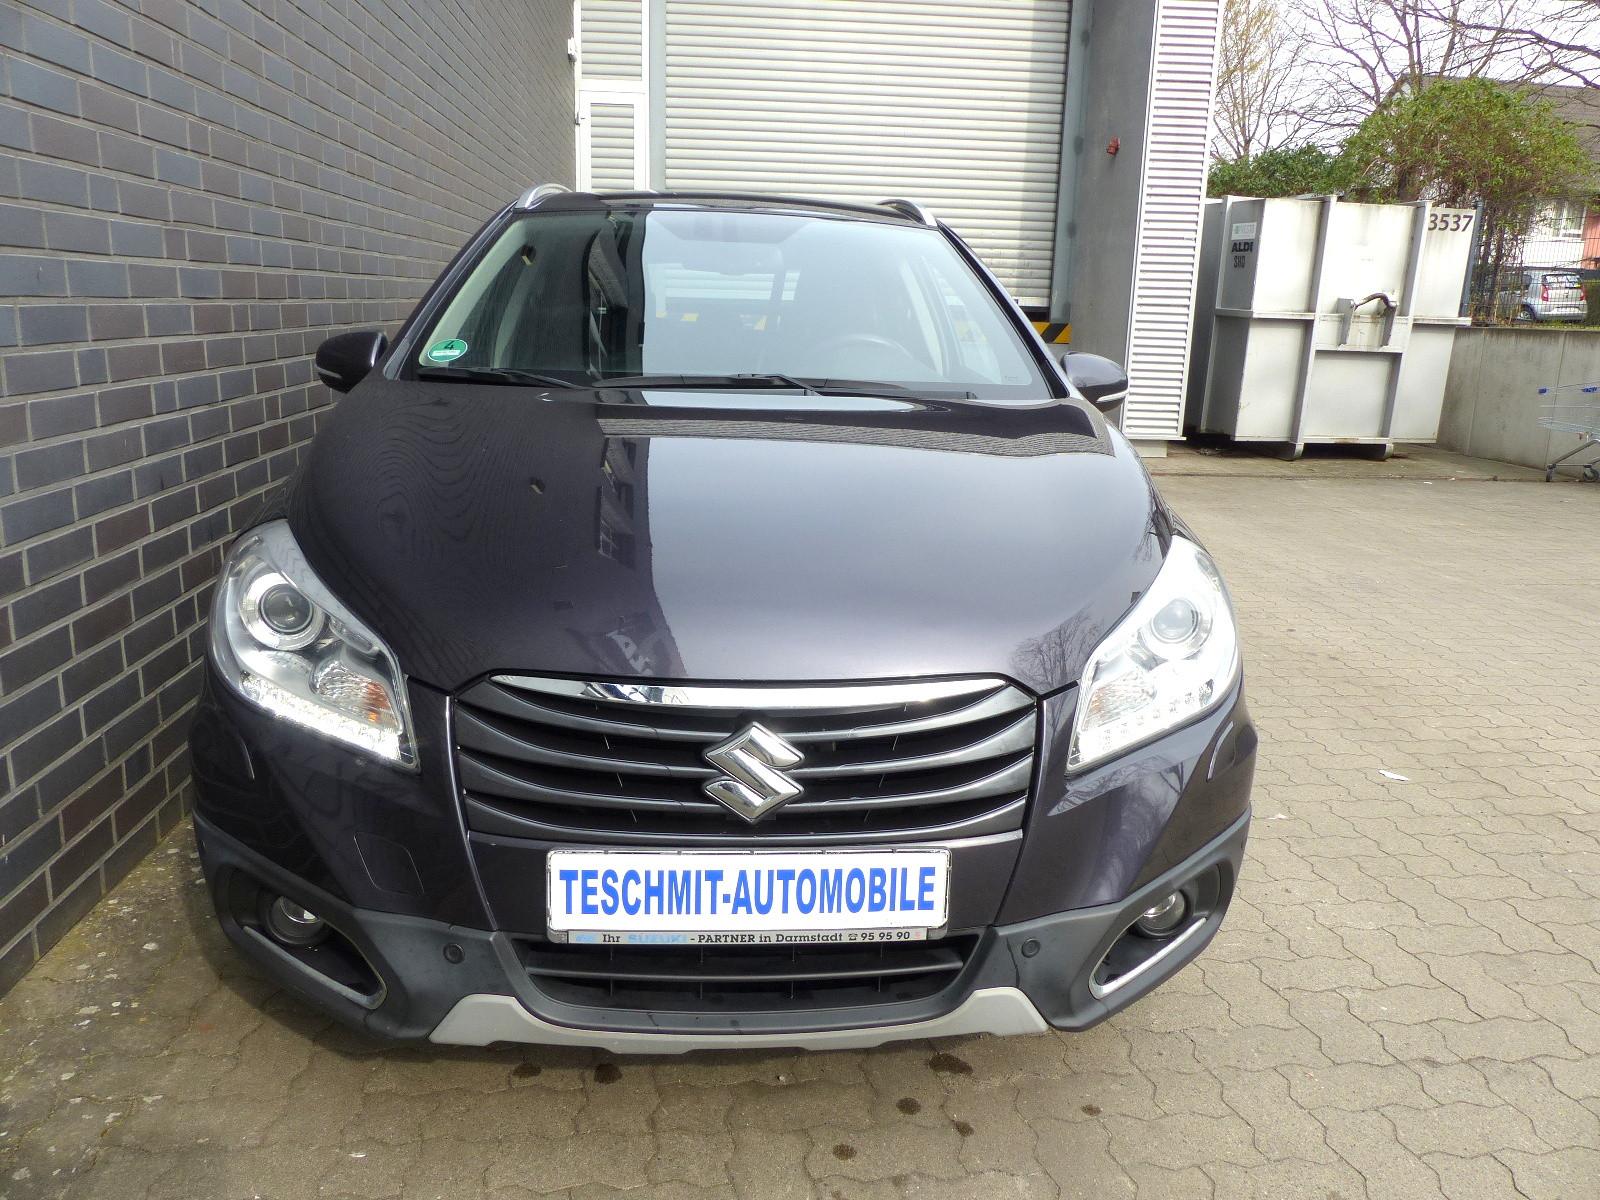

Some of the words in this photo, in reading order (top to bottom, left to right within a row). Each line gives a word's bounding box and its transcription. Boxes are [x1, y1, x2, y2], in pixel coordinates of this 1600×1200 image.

[1428, 213, 1473, 232] 3537
[559, 866, 936, 916] TESCHMIT-AUTOMOBILE
[602, 934, 621, 943] Ihr
[758, 933, 772, 943] in
[775, 932, 843, 943] Darmstadt
[860, 932, 875, 941] 95
[878, 931, 893, 941] 95
[896, 931, 911, 940] 90
